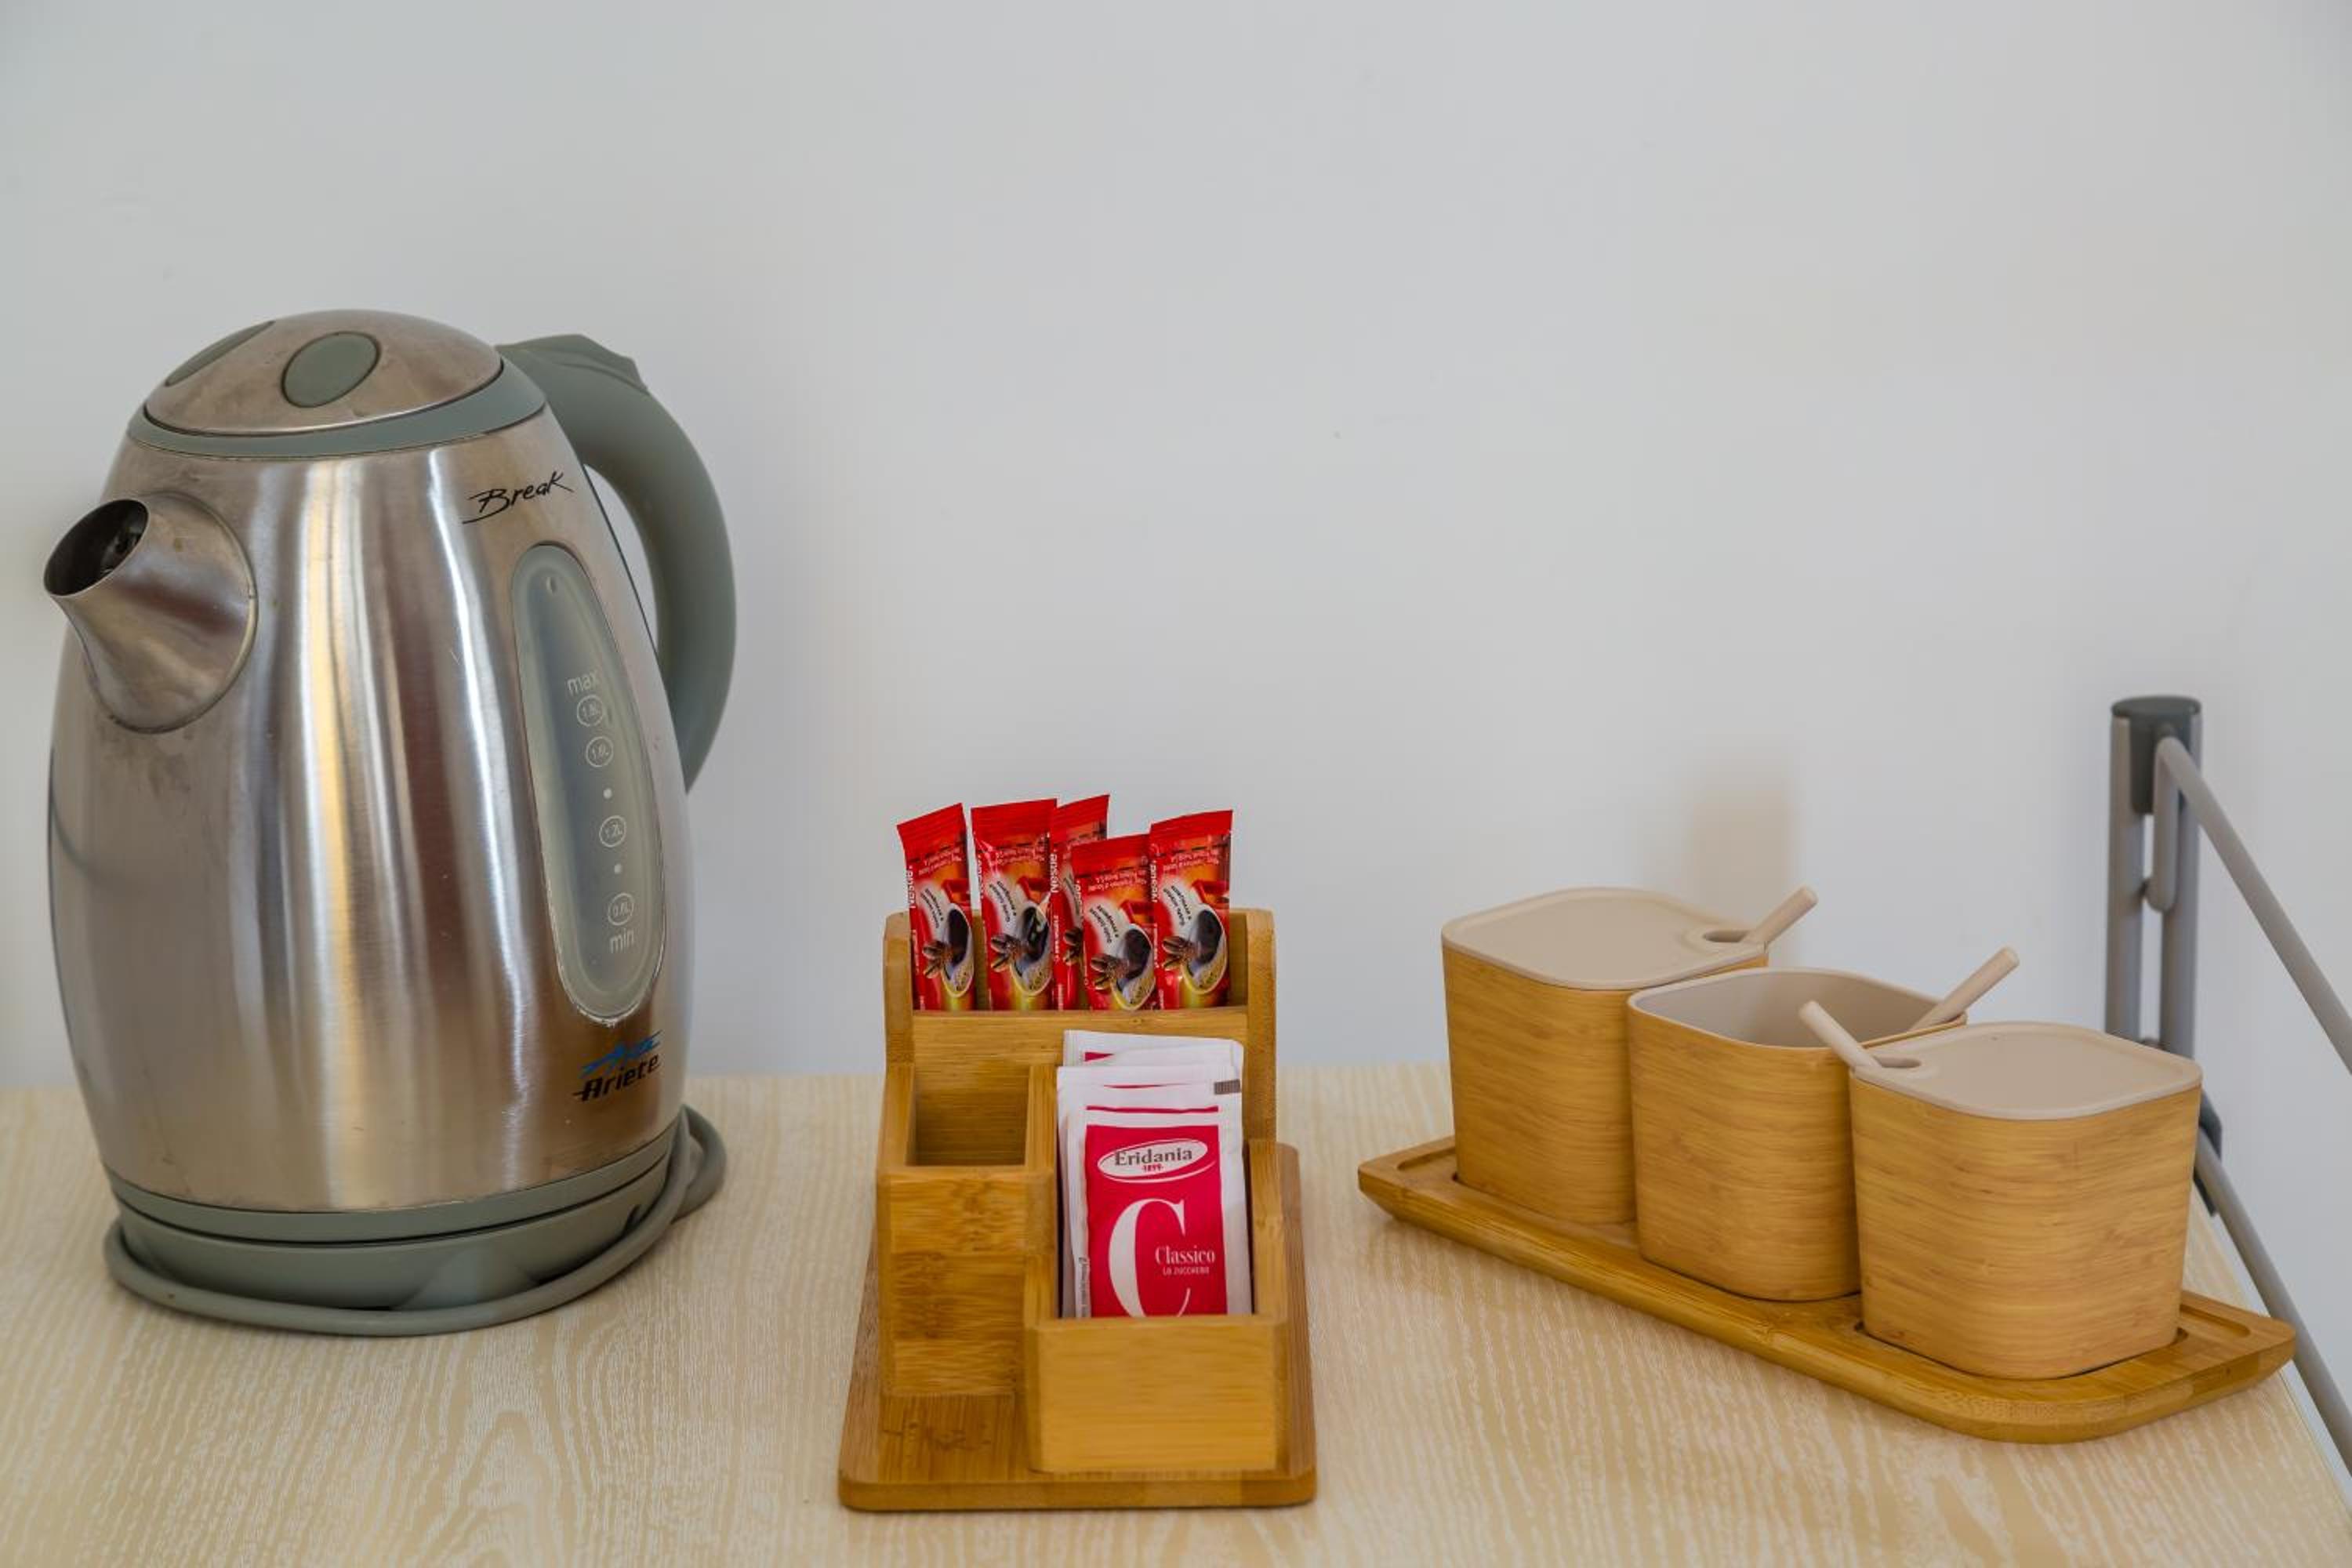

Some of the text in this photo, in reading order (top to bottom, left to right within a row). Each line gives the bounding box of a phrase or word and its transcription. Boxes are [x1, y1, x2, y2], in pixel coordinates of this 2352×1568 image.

[462, 470, 575, 524] Break
[609, 928, 634, 953] min
[572, 1054, 659, 1102] Ariete
[1115, 1147, 1192, 1167] Eridania
[1109, 1197, 1191, 1317] C
[1155, 1245, 1215, 1265] Classico
